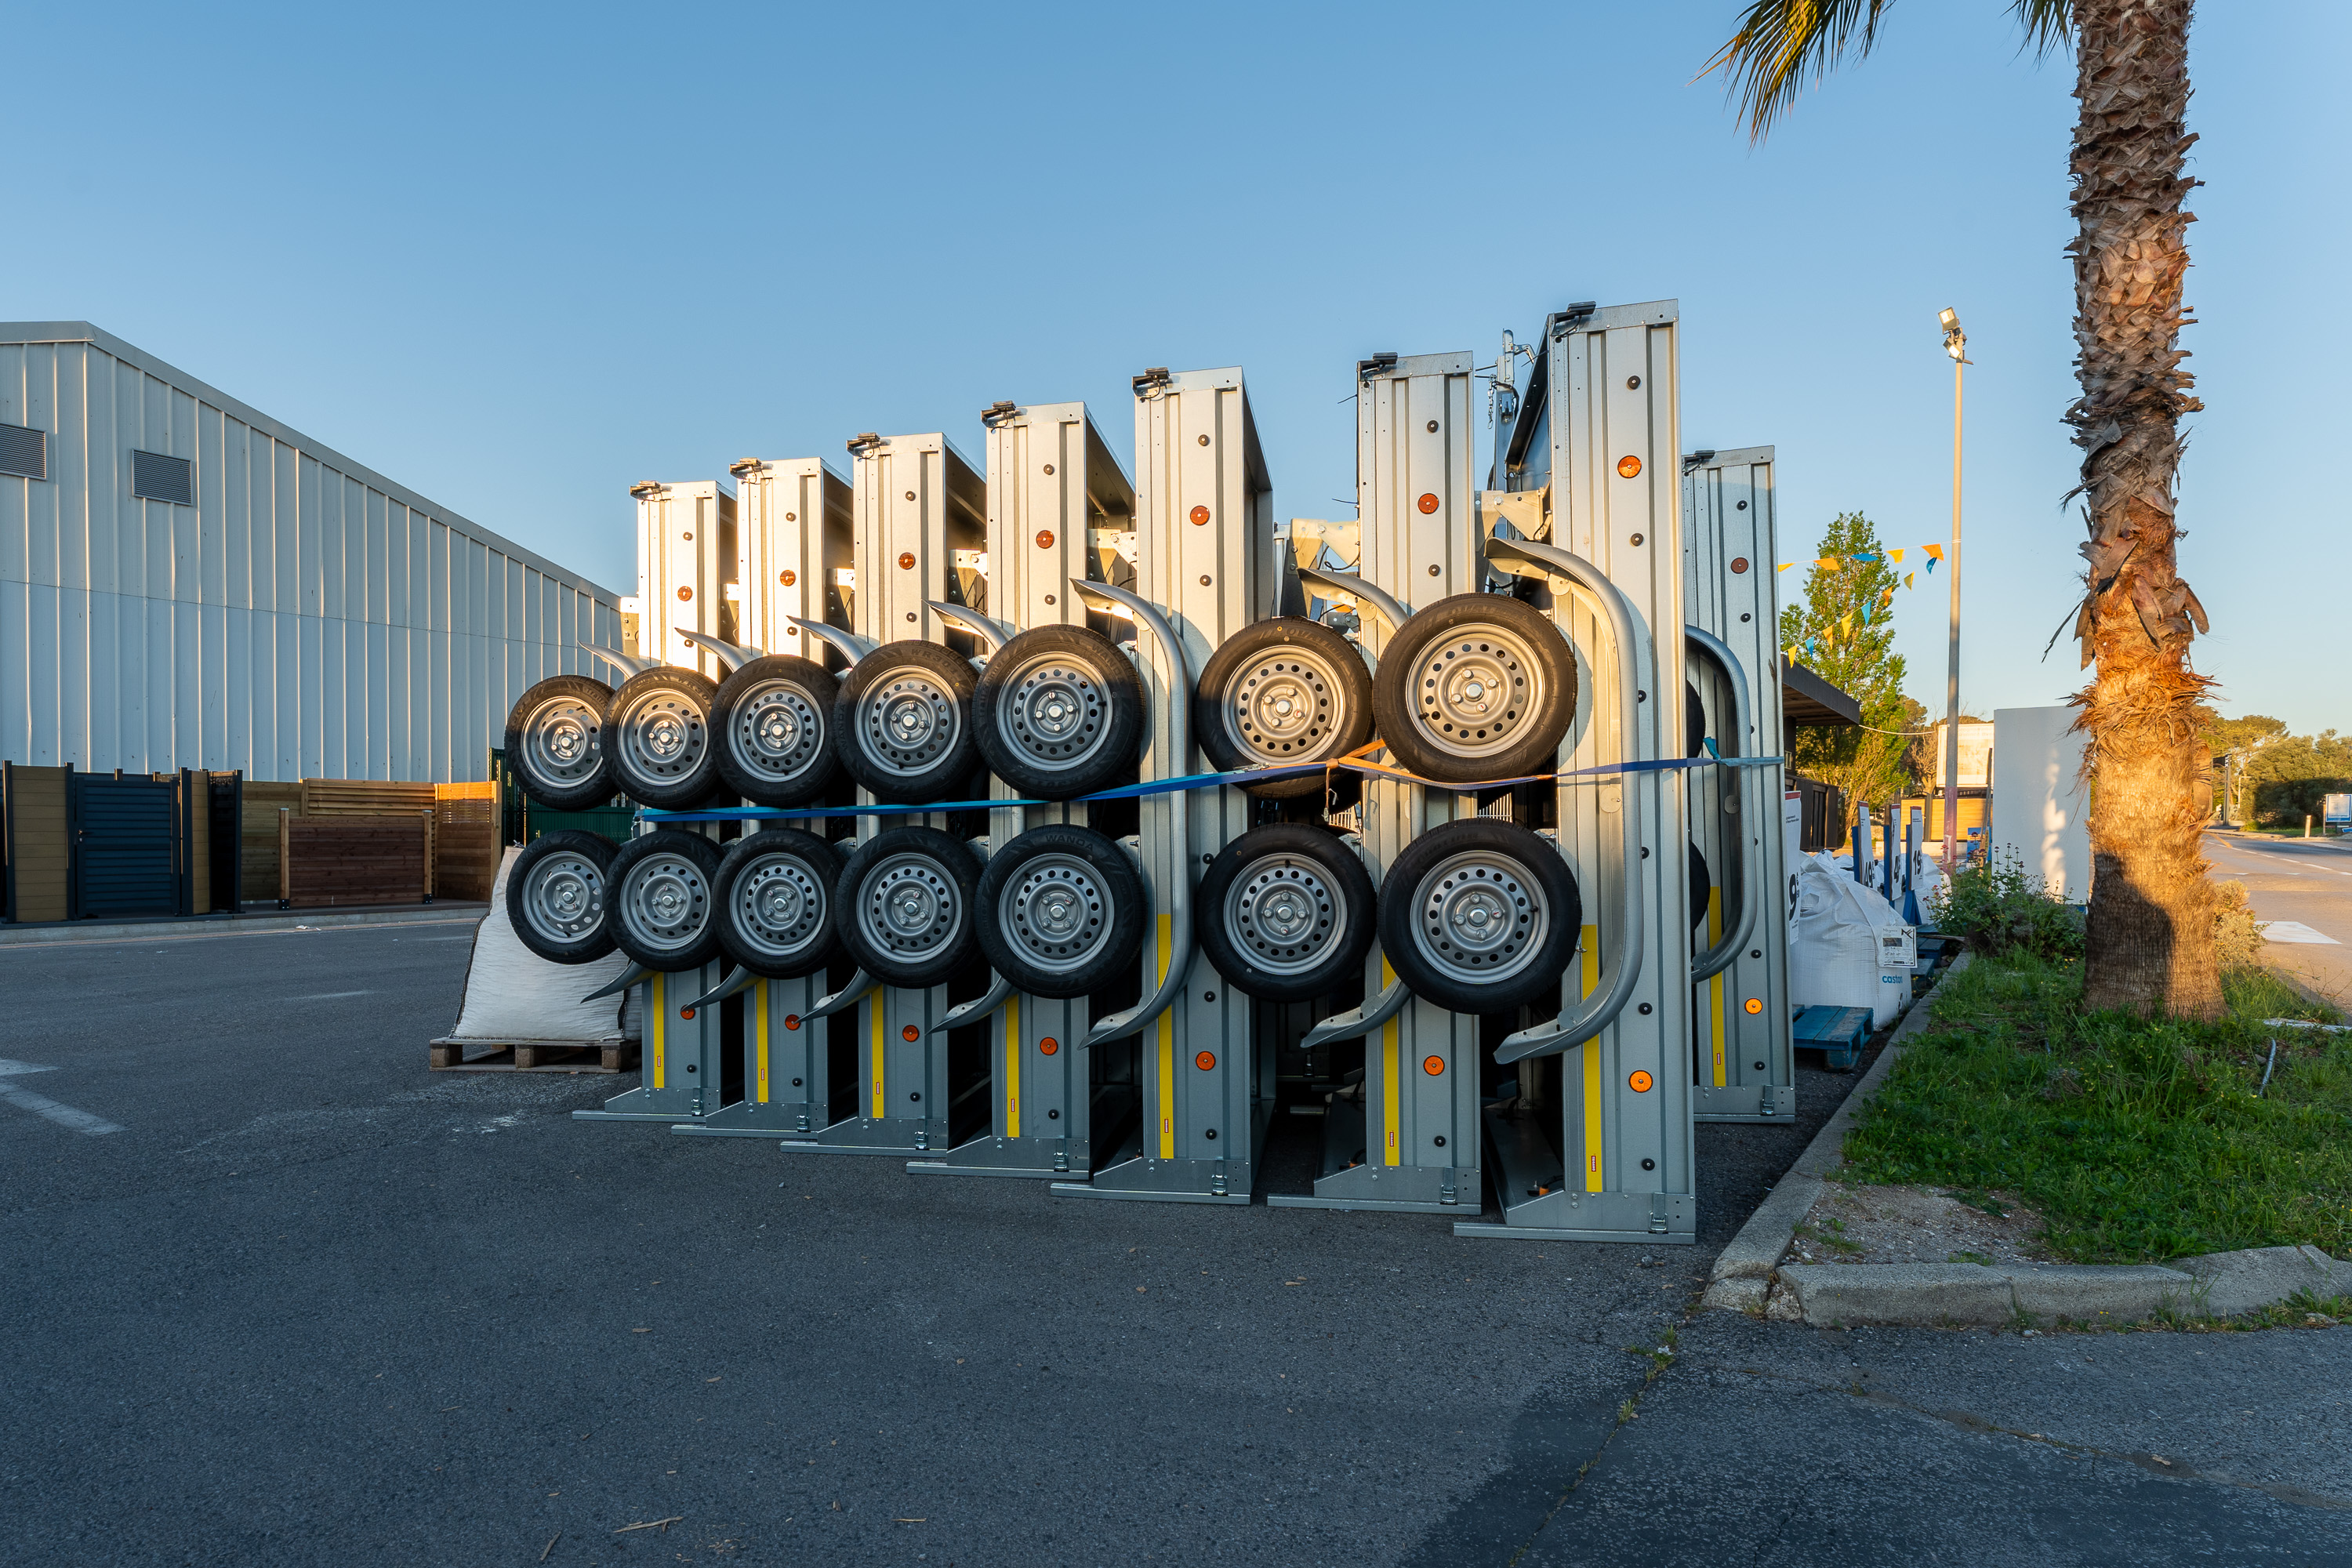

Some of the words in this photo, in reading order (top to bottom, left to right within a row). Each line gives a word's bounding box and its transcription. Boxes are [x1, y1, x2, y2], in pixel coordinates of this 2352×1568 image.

[715, 672, 745, 711] WANDA
[602, 706, 615, 750] WANDA
[837, 702, 850, 751] WANDA
[518, 837, 553, 865] WANDA
[1044, 833, 1096, 852] WANDA
[1913, 849, 1922, 876] 19
[839, 864, 858, 911] WANDA
